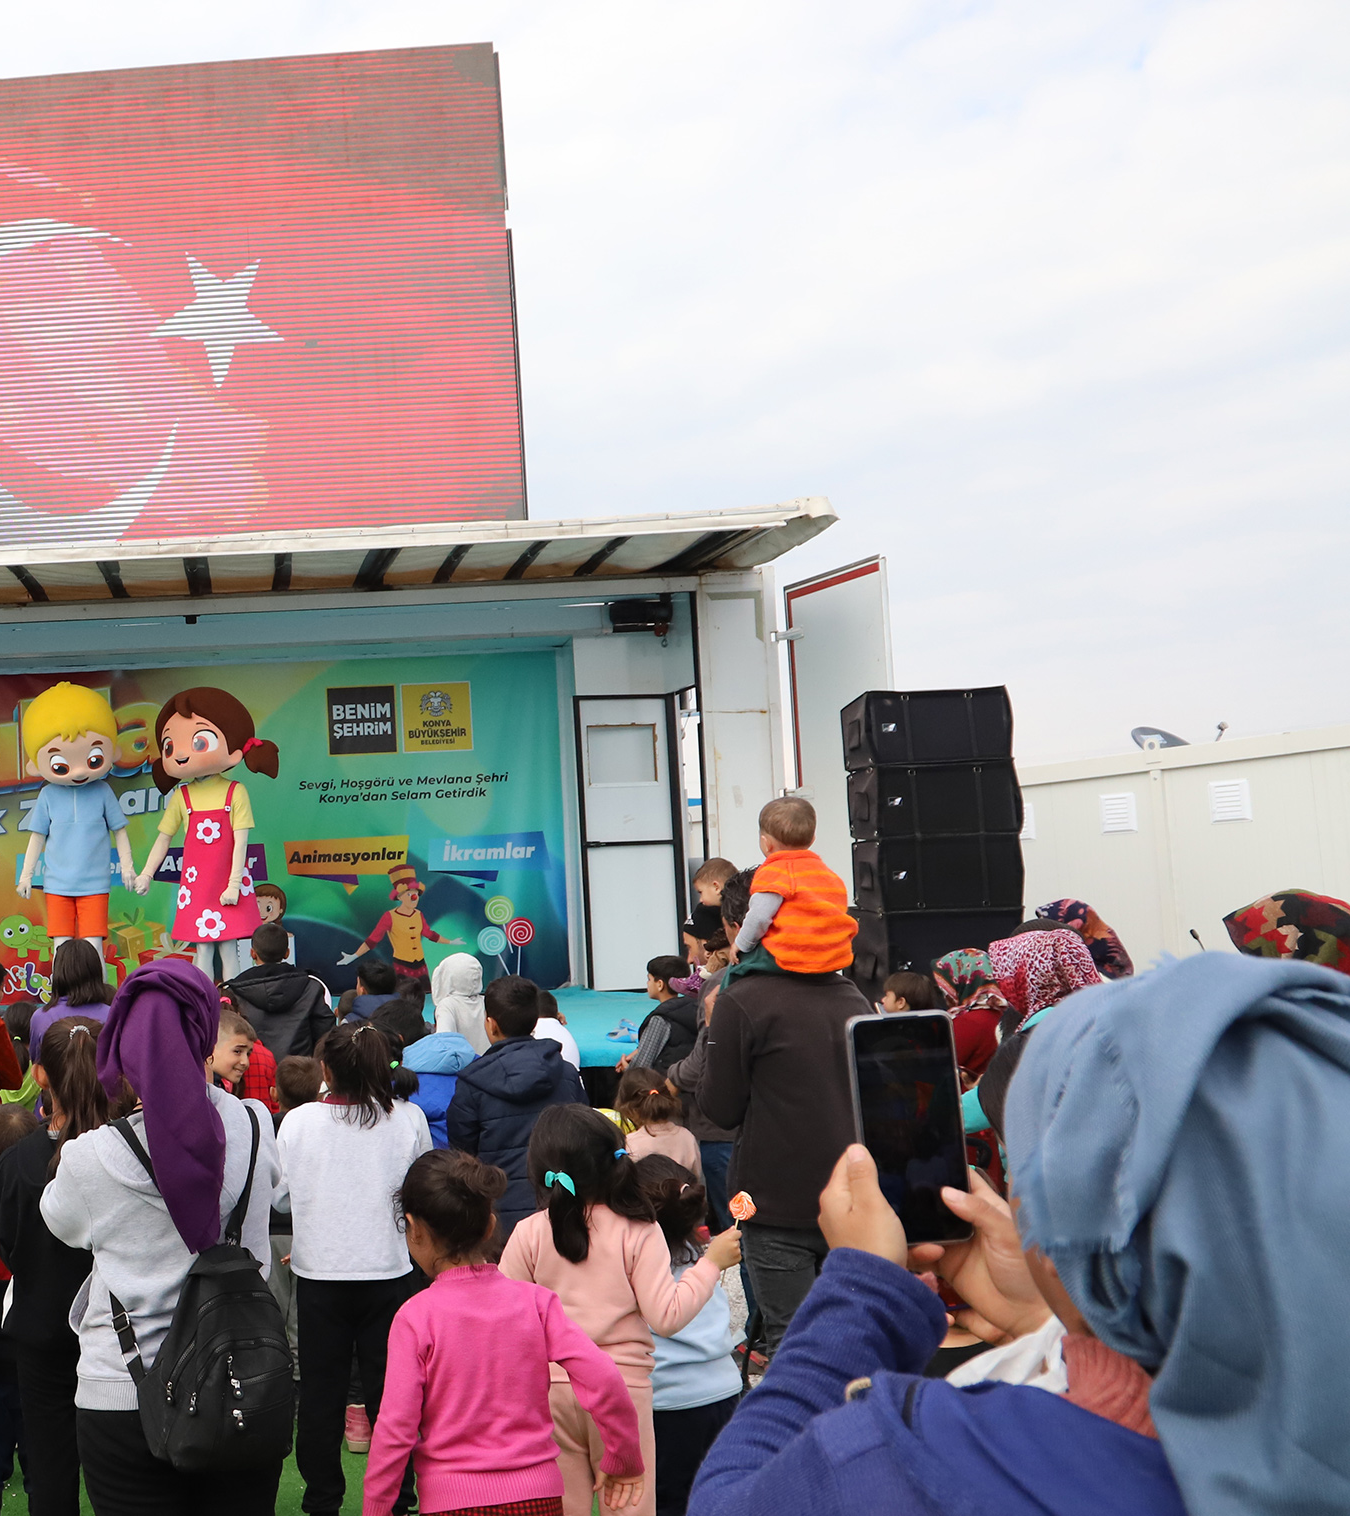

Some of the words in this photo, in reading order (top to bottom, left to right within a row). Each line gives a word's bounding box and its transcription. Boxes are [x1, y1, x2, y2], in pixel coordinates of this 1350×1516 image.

[422, 719, 452, 728] KONYA
[408, 726, 467, 739] BÜYÜKŞEHİR
[420, 737, 455, 746] BELEDİYESİ
[299, 778, 337, 792] Sevgi,
[340, 777, 395, 791] Hoşgörü
[398, 777, 413, 787] ve
[416, 774, 472, 786] Mevlana
[476, 772, 509, 786] Şehri
[391, 790, 431, 801] Selam
[435, 787, 488, 799] Getirdik
[289, 847, 404, 866] Animasyonlar
[443, 840, 536, 861] İkramlar
